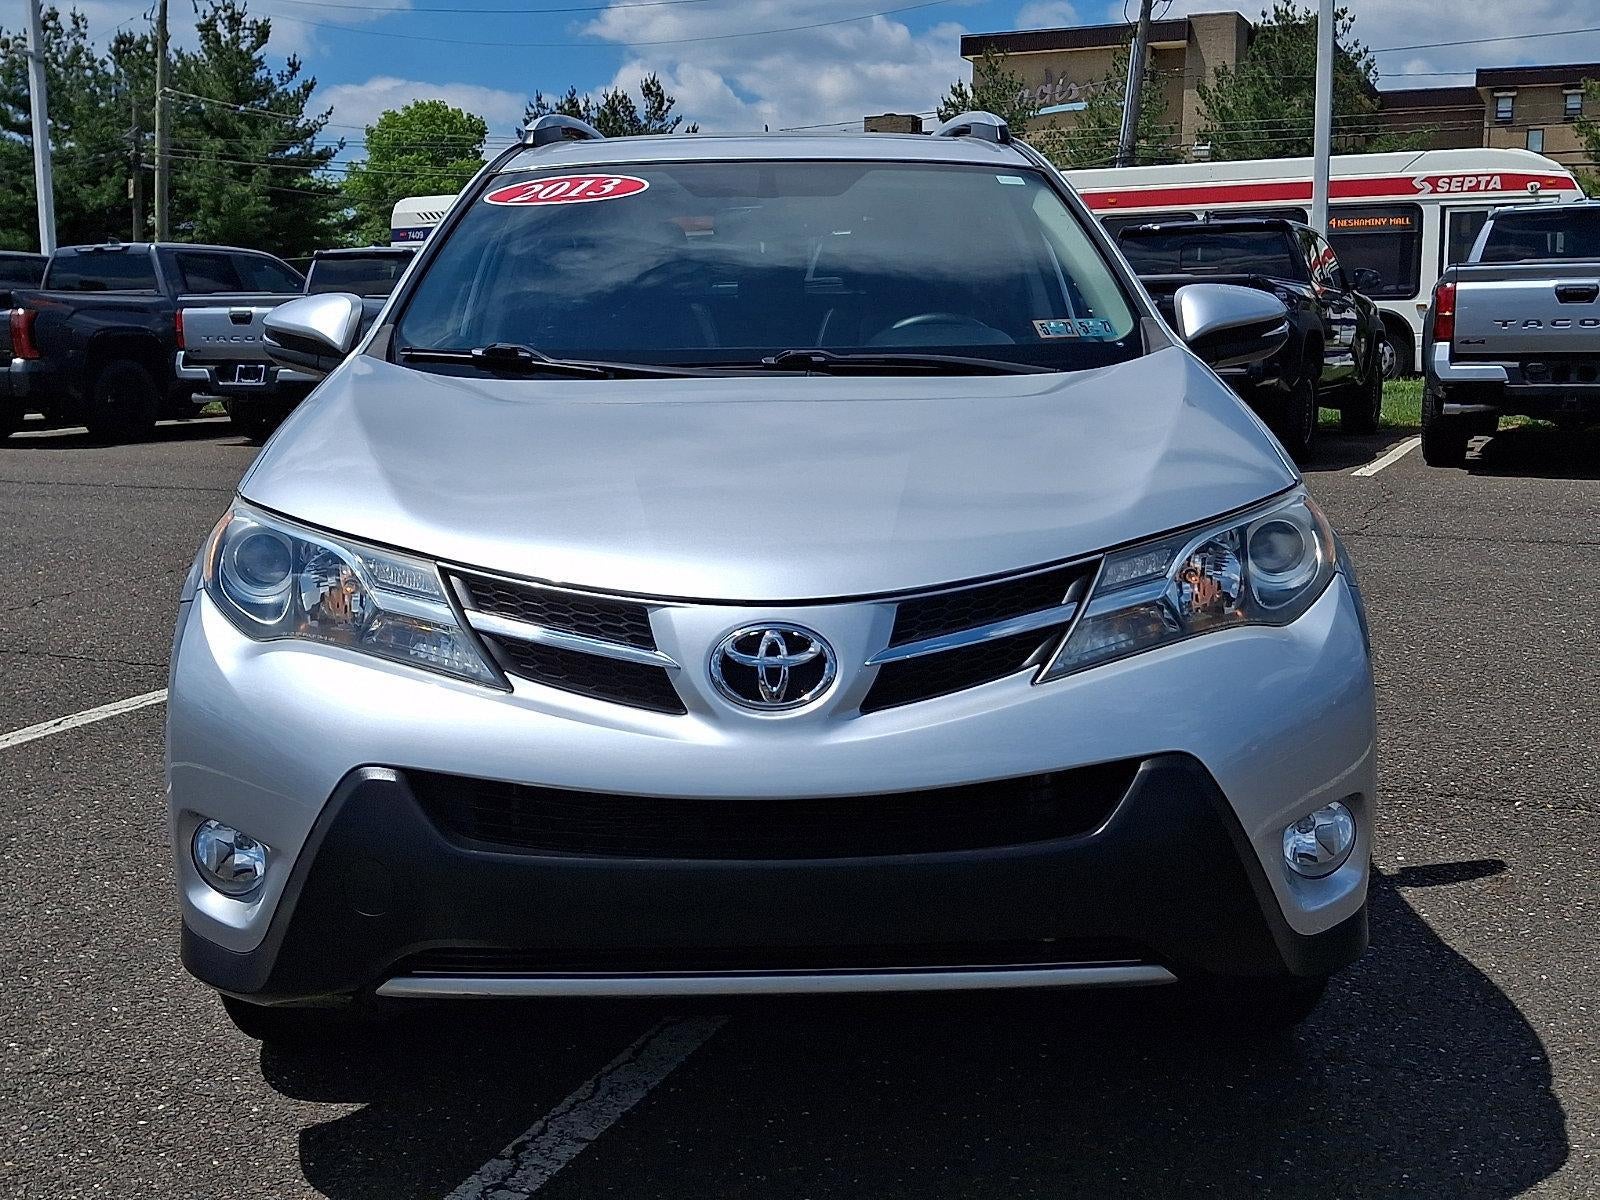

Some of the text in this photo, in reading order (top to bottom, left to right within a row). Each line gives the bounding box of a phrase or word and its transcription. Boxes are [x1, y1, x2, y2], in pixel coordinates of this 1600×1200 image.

[1437, 175, 1502, 192] SEPTA
[507, 178, 622, 203] 2013
[1337, 218, 1388, 227] NESHAMINY
[1389, 217, 1411, 226] MALL
[408, 231, 424, 240] 7409
[201, 335, 264, 343] TACO
